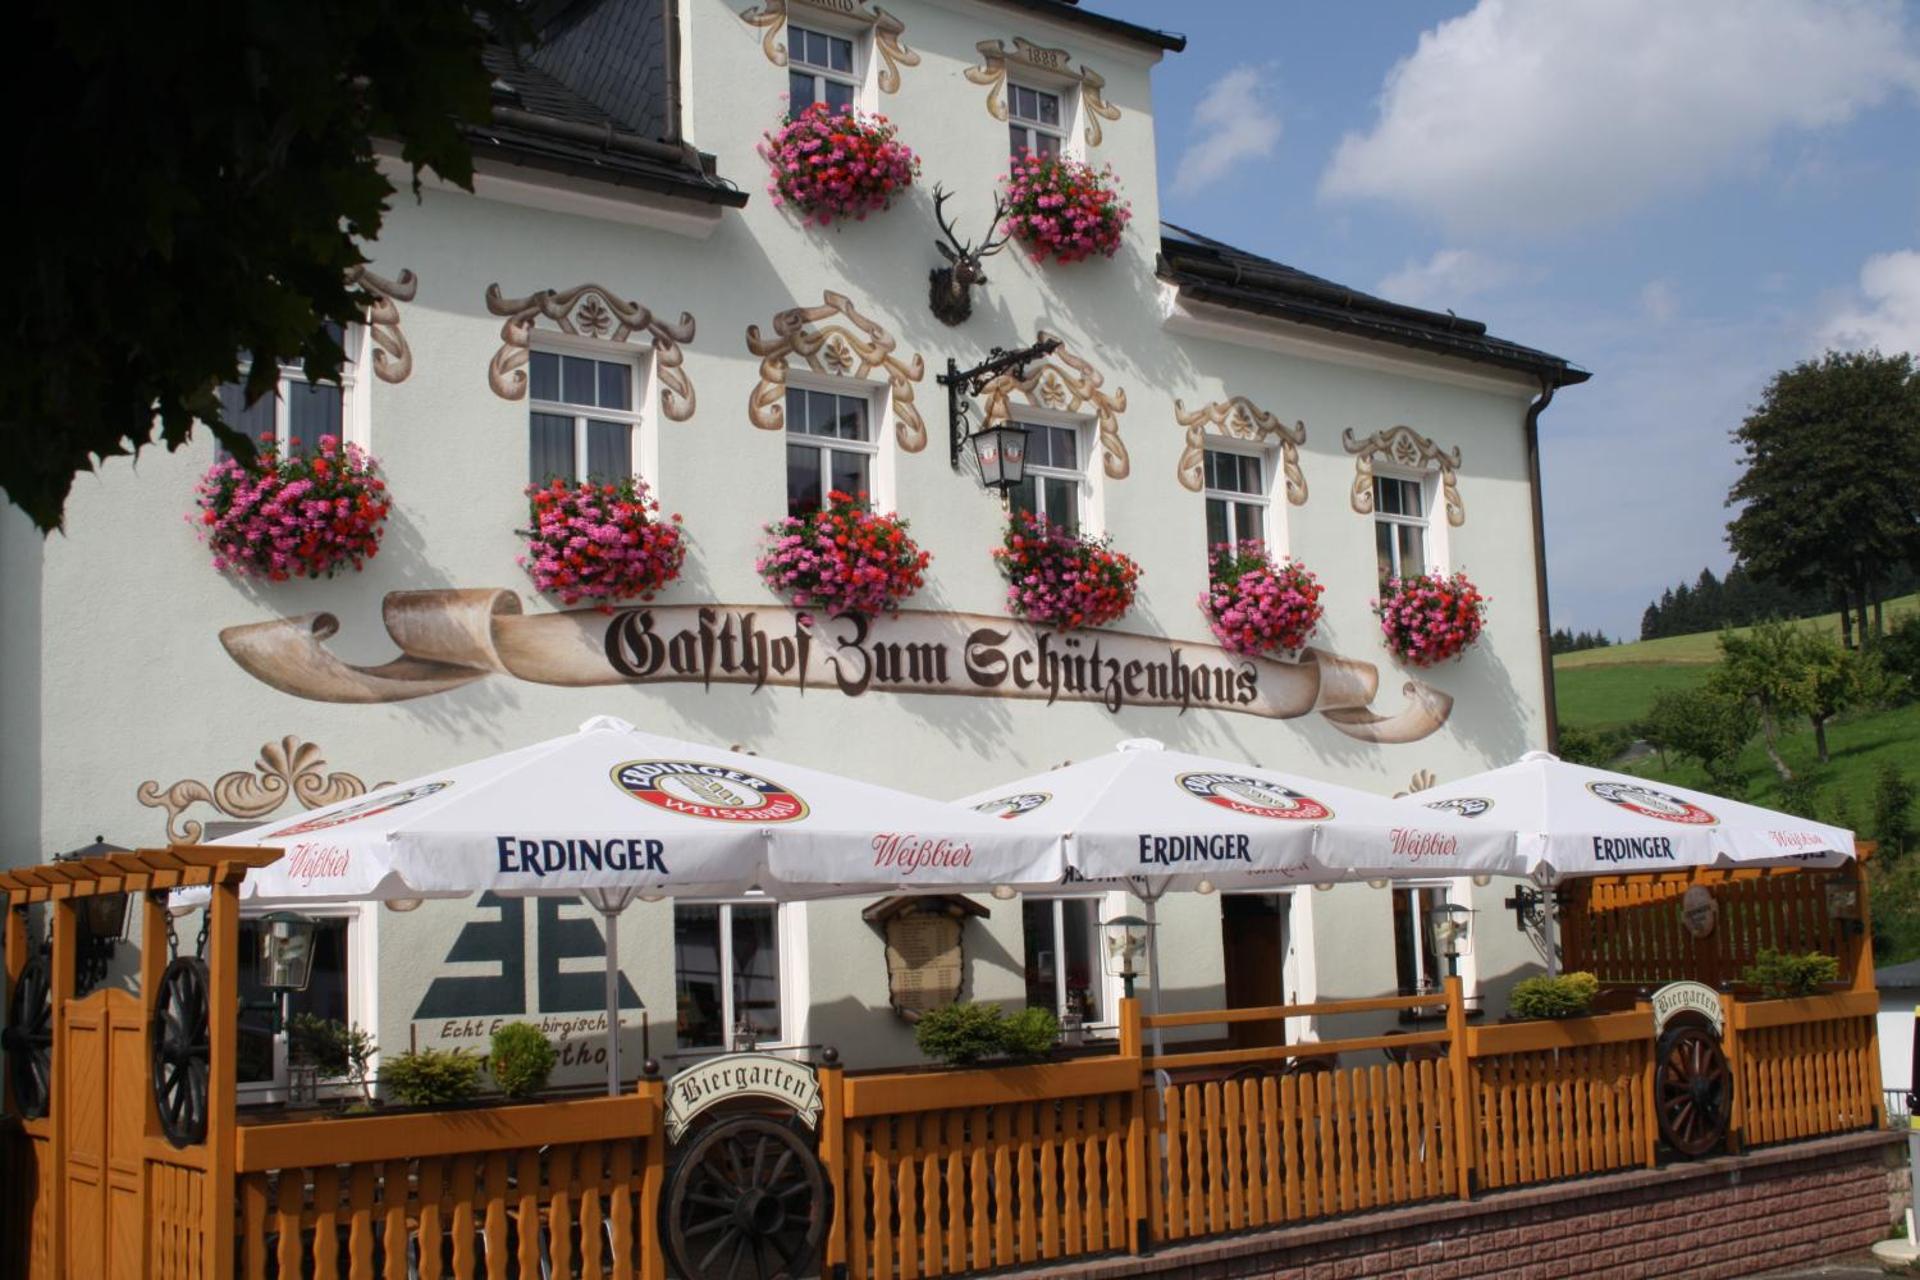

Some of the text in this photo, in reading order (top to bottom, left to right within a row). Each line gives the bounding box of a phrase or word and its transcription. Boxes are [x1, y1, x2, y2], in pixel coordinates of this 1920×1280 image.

[825, 612, 950, 697] Zum
[965, 628, 1258, 716] Schützenhaus
[622, 763, 767, 790] ERDINGER
[496, 836, 669, 877] ERDINGER
[872, 833, 974, 875] Weißbier
[1139, 834, 1252, 866] ERDINGER
[1390, 828, 1457, 862] Weißbier
[1593, 836, 1675, 863] ERDINGER
[1659, 990, 1717, 1014] Biergarten
[441, 1020, 484, 1039] Echt
[678, 1066, 807, 1111] Biergarten
